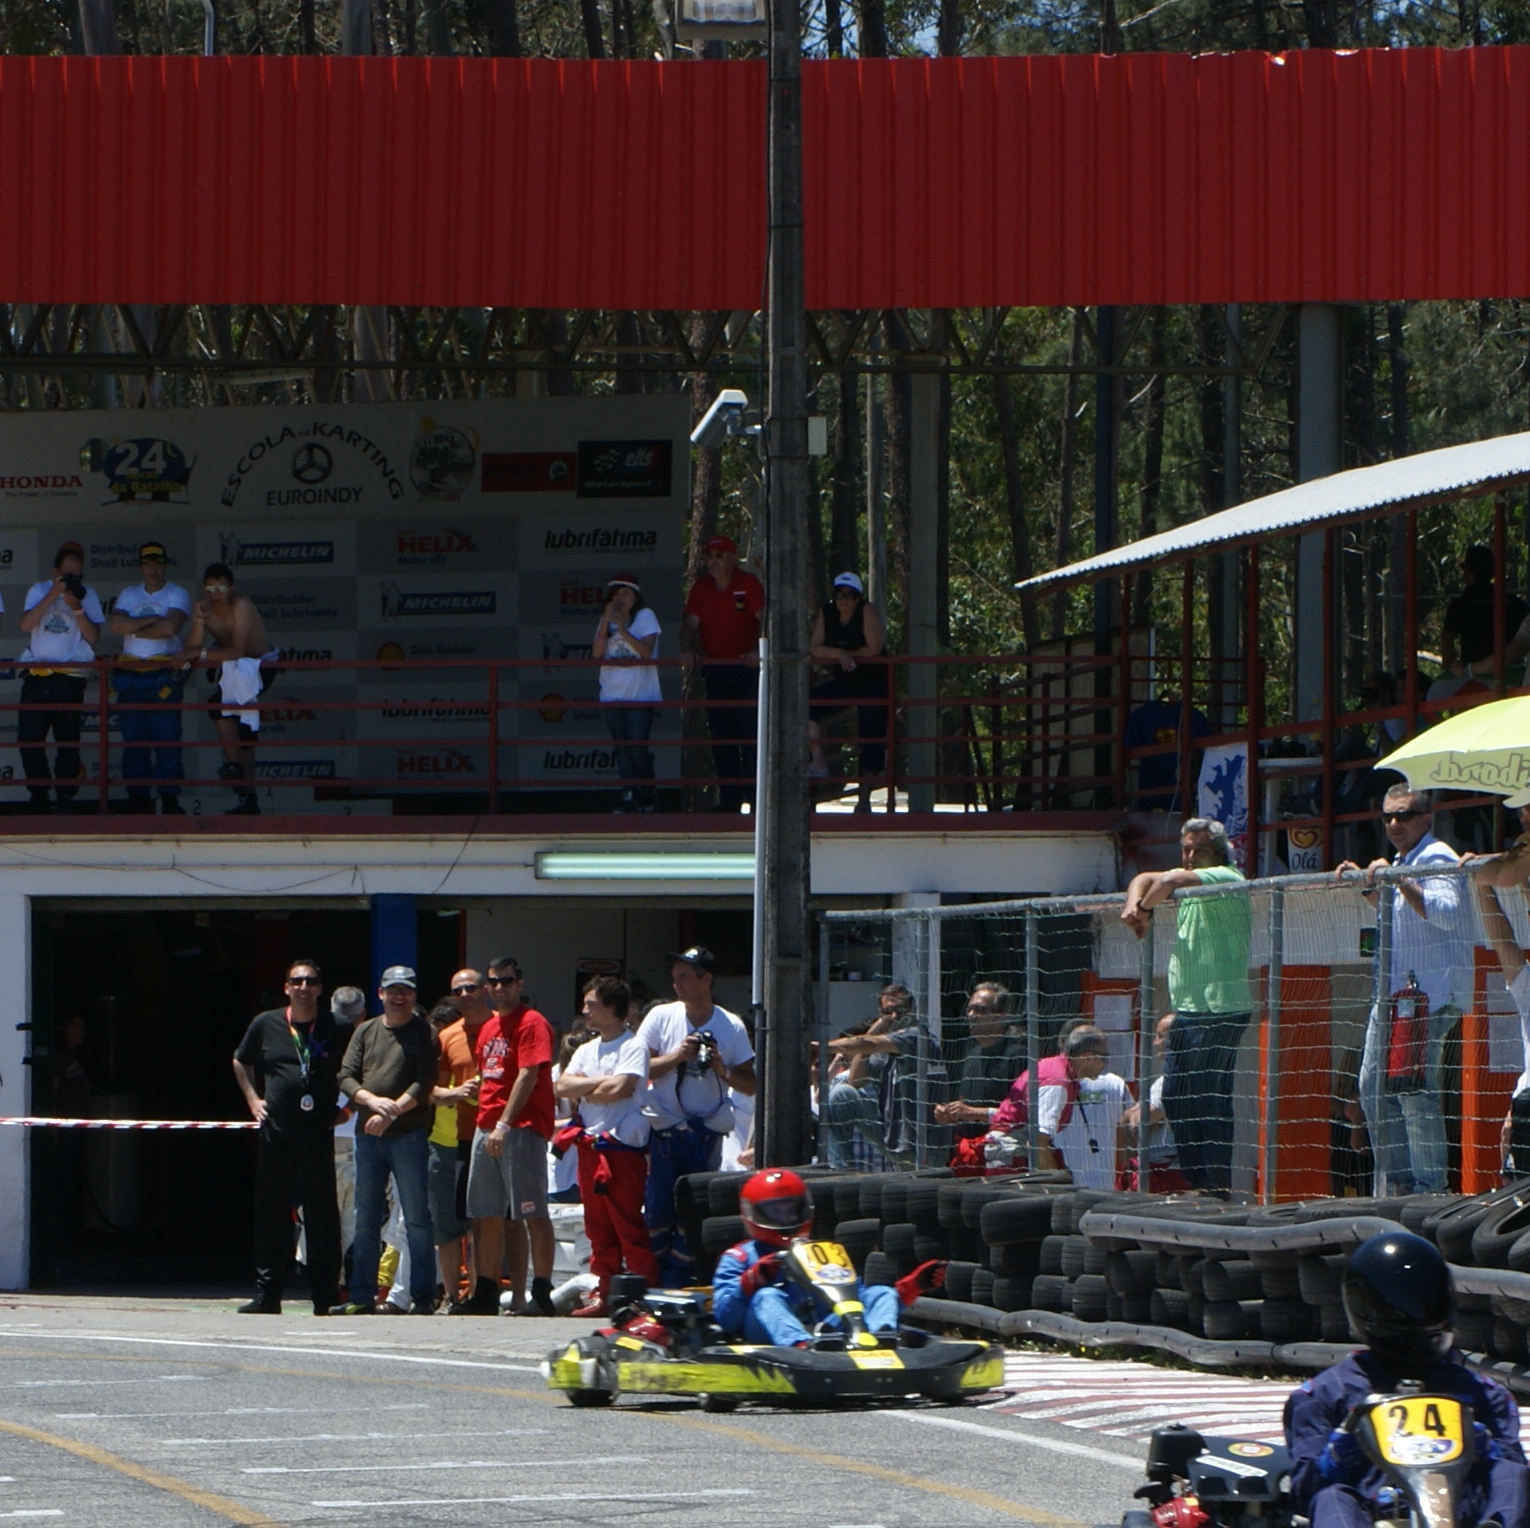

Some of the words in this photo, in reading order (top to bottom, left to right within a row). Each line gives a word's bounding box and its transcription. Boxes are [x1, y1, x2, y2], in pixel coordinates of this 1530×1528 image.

[114, 441, 168, 476] 24
[221, 427, 296, 508] ESCOLA
[313, 422, 405, 500] KARTING
[0, 475, 84, 490] HONDA
[266, 486, 363, 506] EUROINDY
[243, 542, 331, 560] MICHELIN
[397, 534, 474, 553] HELIX
[404, 593, 493, 610] MICHELIN
[397, 756, 475, 774] HELIX
[1291, 851, 1317, 871] Olá
[1388, 1403, 1447, 1438] 24
